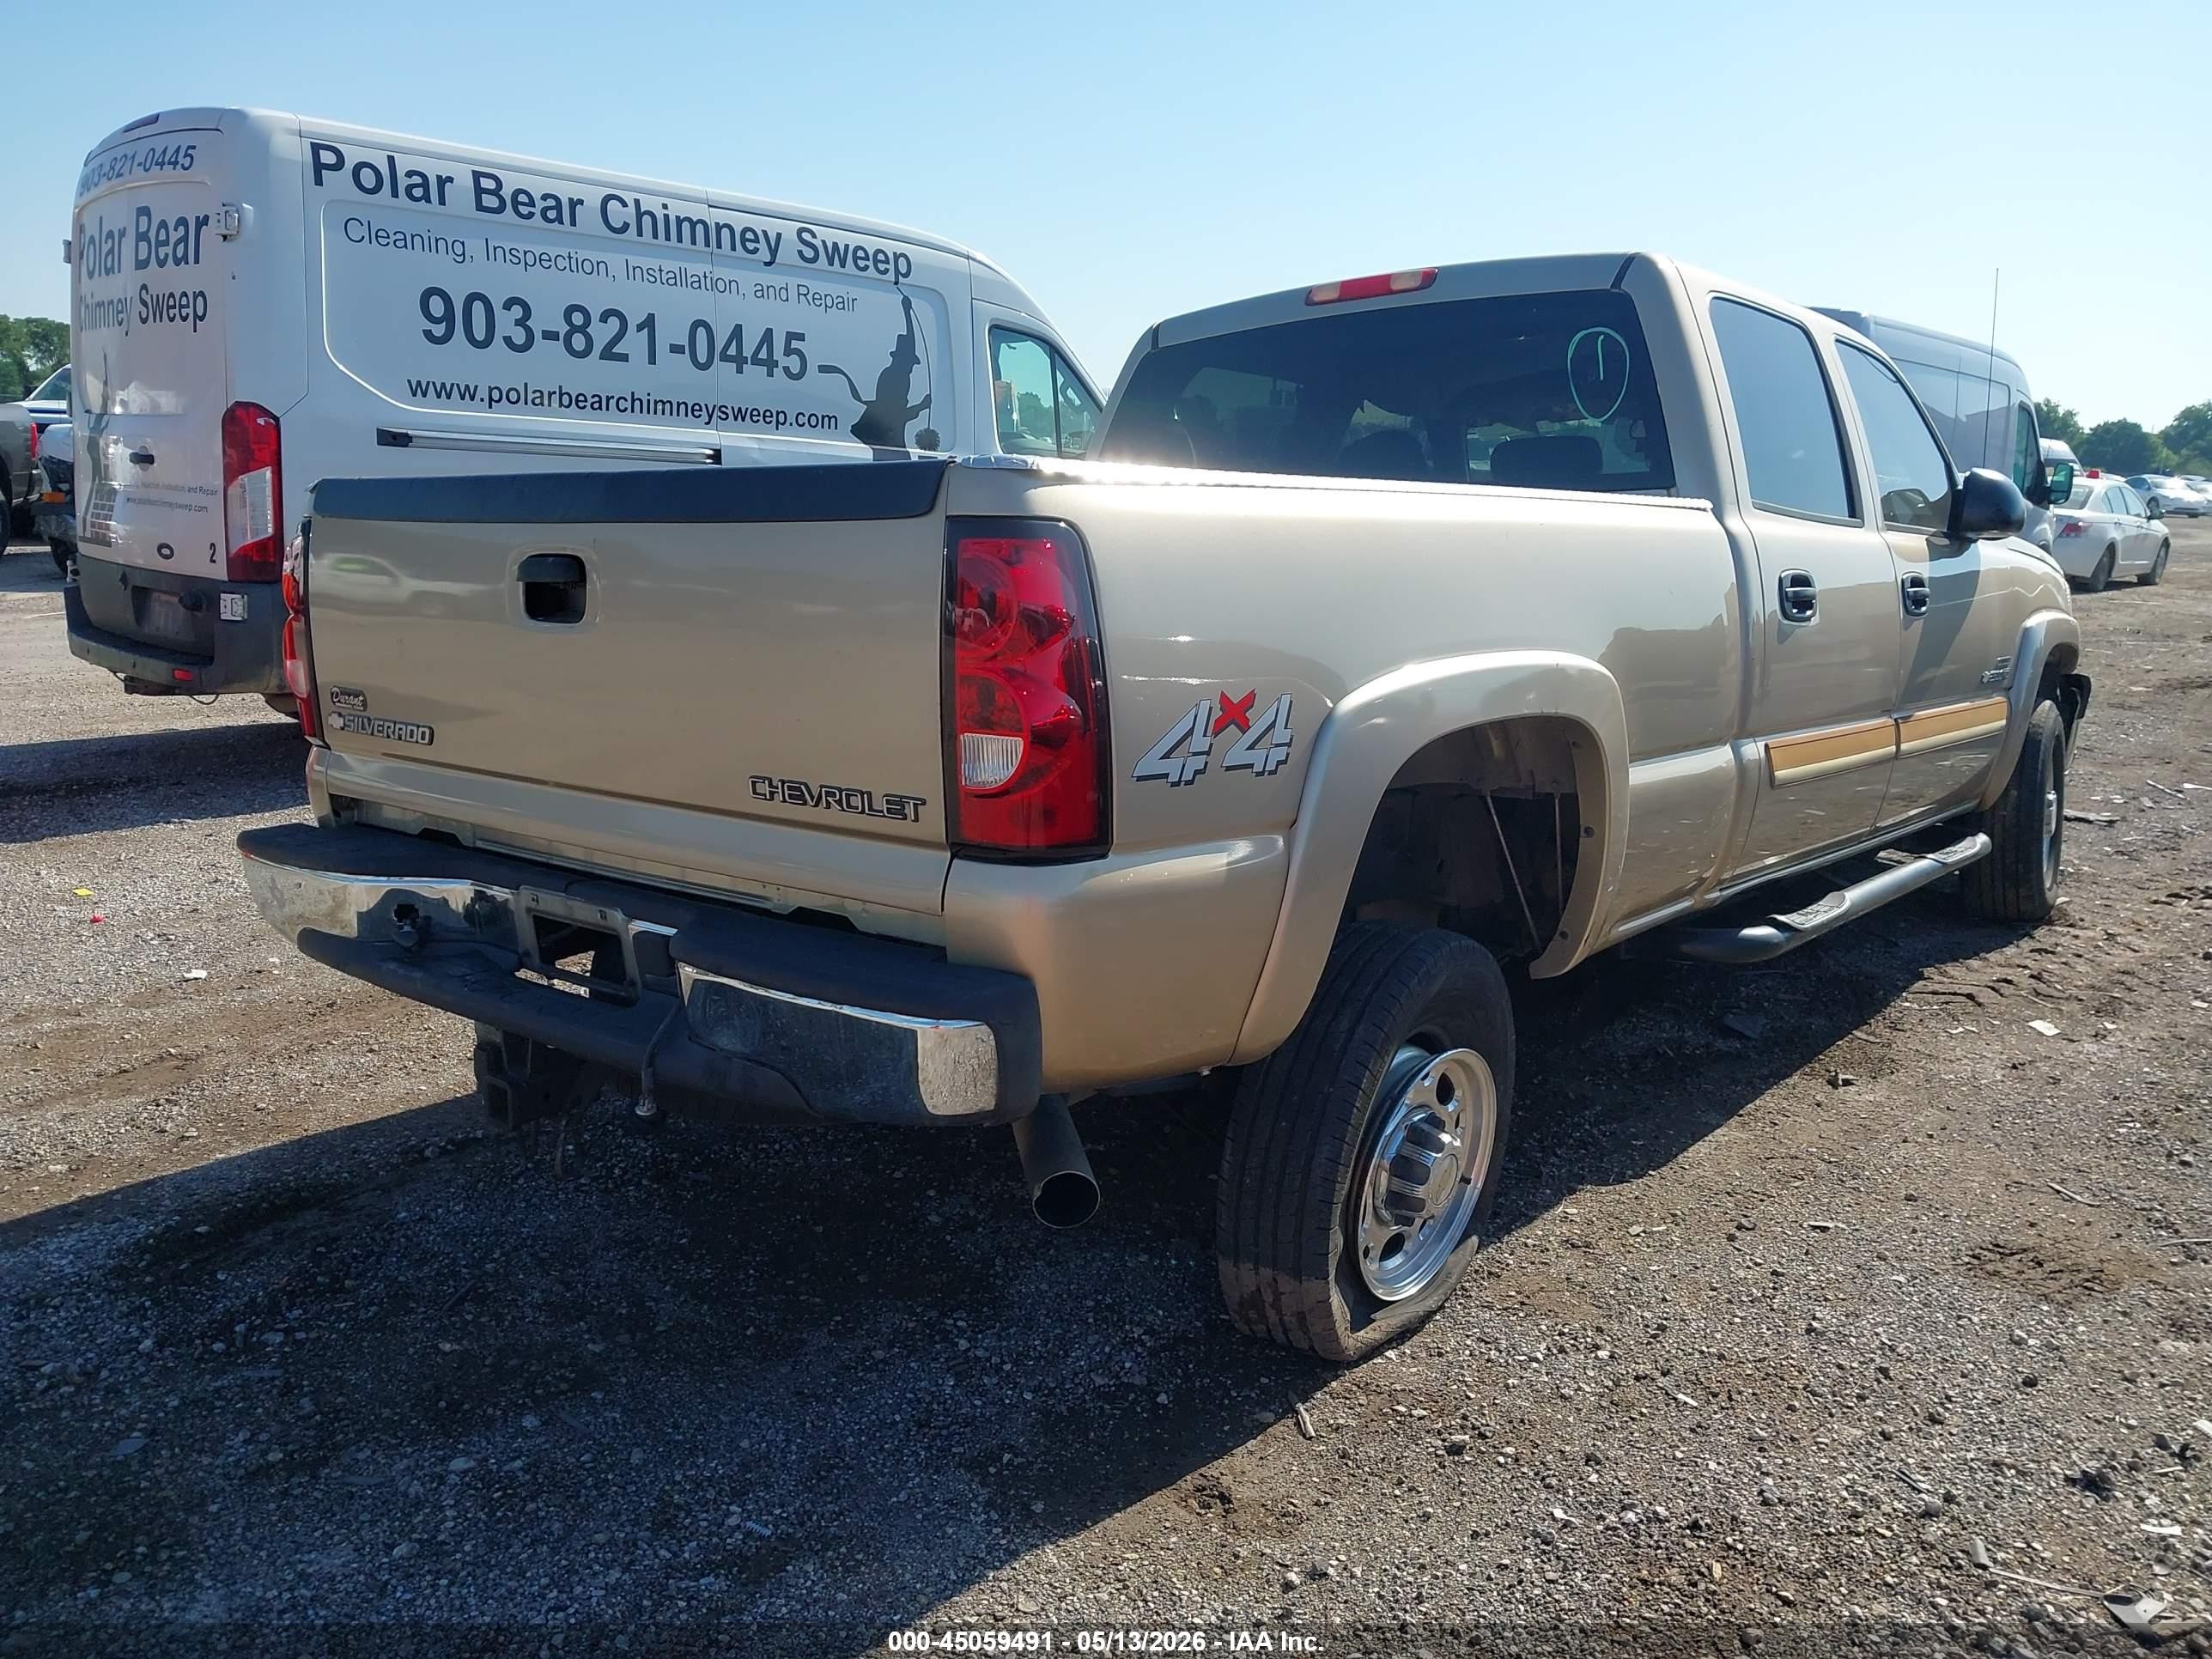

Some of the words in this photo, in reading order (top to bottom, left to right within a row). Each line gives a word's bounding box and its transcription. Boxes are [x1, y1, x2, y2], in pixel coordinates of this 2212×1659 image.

[79, 144, 197, 198] 903-821-0445
[309, 141, 454, 207] Polar
[471, 169, 584, 228] Bear
[600, 193, 782, 267] Chimney
[796, 227, 912, 285] Sweep
[79, 216, 126, 283] Polar
[134, 205, 210, 271] Bear
[343, 217, 474, 264] Cleaning,
[485, 238, 617, 282] Inspection,
[625, 258, 746, 301] Installation,
[753, 282, 789, 303] and
[797, 284, 857, 313] Repair
[79, 292, 132, 337] Chimney
[138, 283, 208, 333] Sweep
[418, 286, 808, 380] 903-821-0445
[407, 379, 838, 431] www.polarbearchimneysweep.com
[198, 486, 218, 496] Repair
[209, 543, 216, 563] 2
[343, 714, 433, 745] SILVERADO
[749, 775, 927, 823] CHEVROLET
